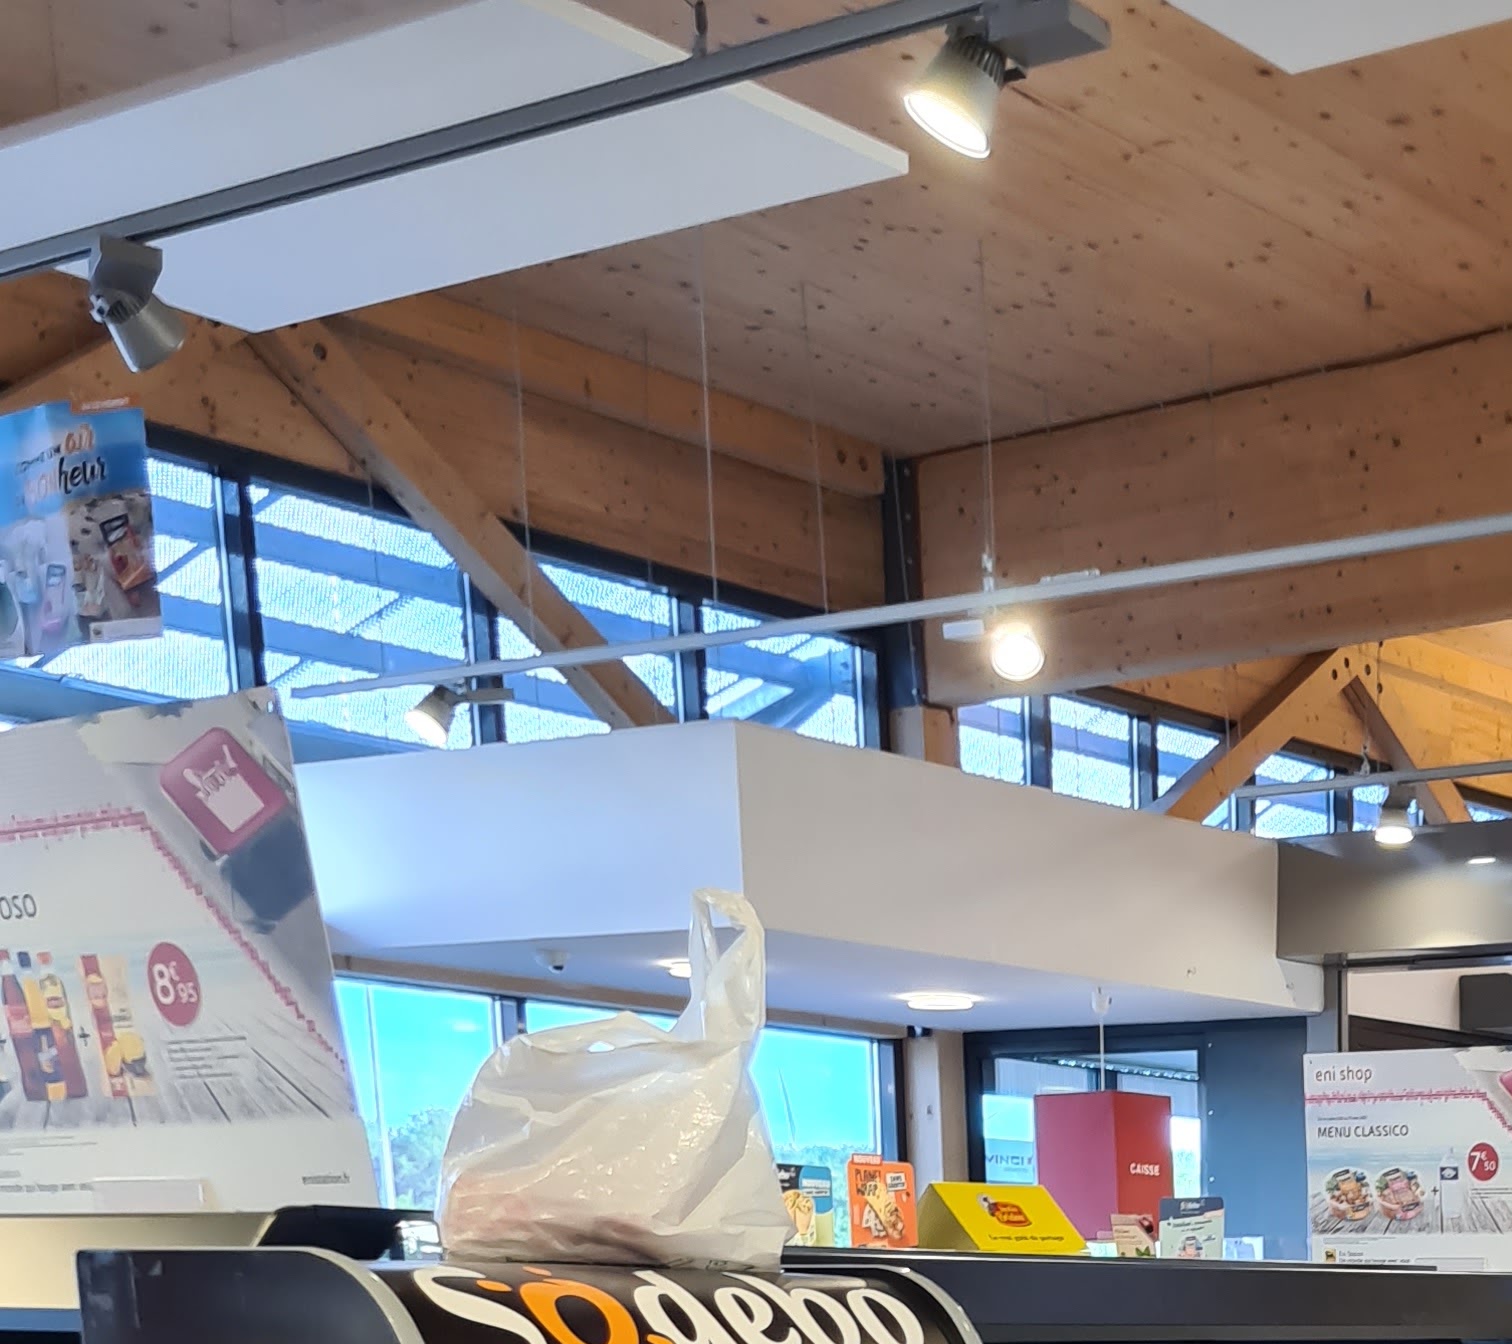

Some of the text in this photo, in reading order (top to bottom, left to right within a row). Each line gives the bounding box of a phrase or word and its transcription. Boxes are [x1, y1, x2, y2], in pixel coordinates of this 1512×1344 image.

[1315, 1066, 1373, 1084] eni shop
[1317, 1124, 1409, 1139] MENU CLASSICO
[985, 1155, 1025, 1166] VINCI
[1129, 1162, 1160, 1176] CAISSE
